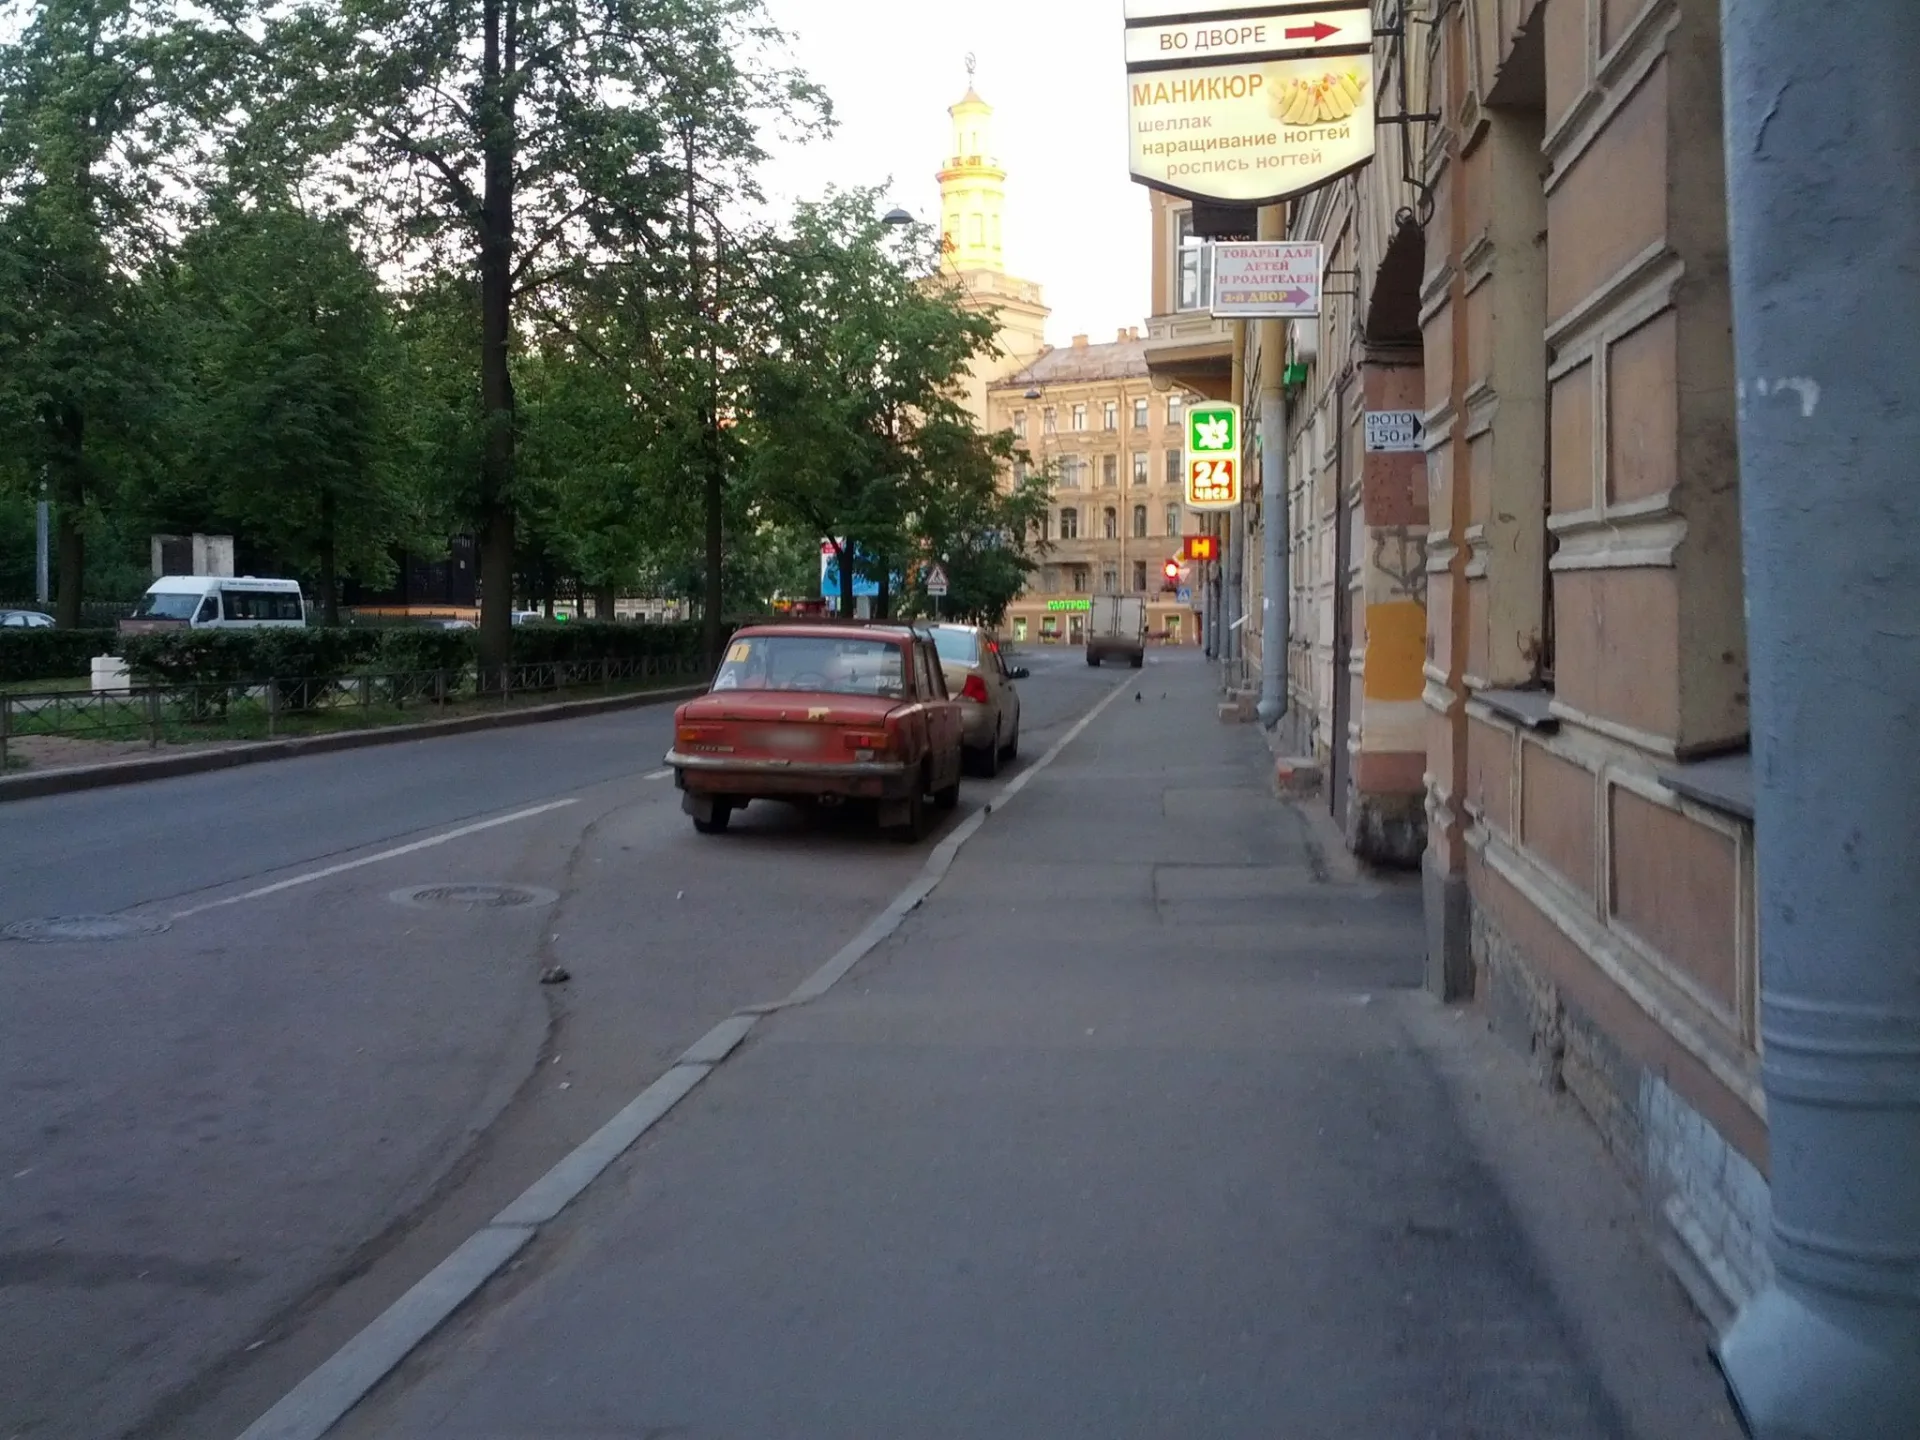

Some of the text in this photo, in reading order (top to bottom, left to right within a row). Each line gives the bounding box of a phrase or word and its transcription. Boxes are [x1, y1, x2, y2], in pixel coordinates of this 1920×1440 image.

[1160, 25, 1267, 51] ВО ДВОРЕ
[1132, 73, 1264, 107] МАНИКЮР
[1138, 114, 1212, 133] шеллак
[1143, 123, 1350, 157] наращивание ногтей
[1166, 148, 1323, 180] роспись ногтей
[1222, 248, 1313, 258] ТОВАРЫ ДЛЯ
[1243, 260, 1289, 272] ДЕТЕЙ
[1219, 273, 1314, 284] И РОДИТЕЛЕЙ
[1247, 291, 1288, 302] ДВОР
[1367, 413, 1412, 425] ФОТО
[1194, 460, 1230, 488] 24
[1194, 487, 1229, 500] ЧАСА
